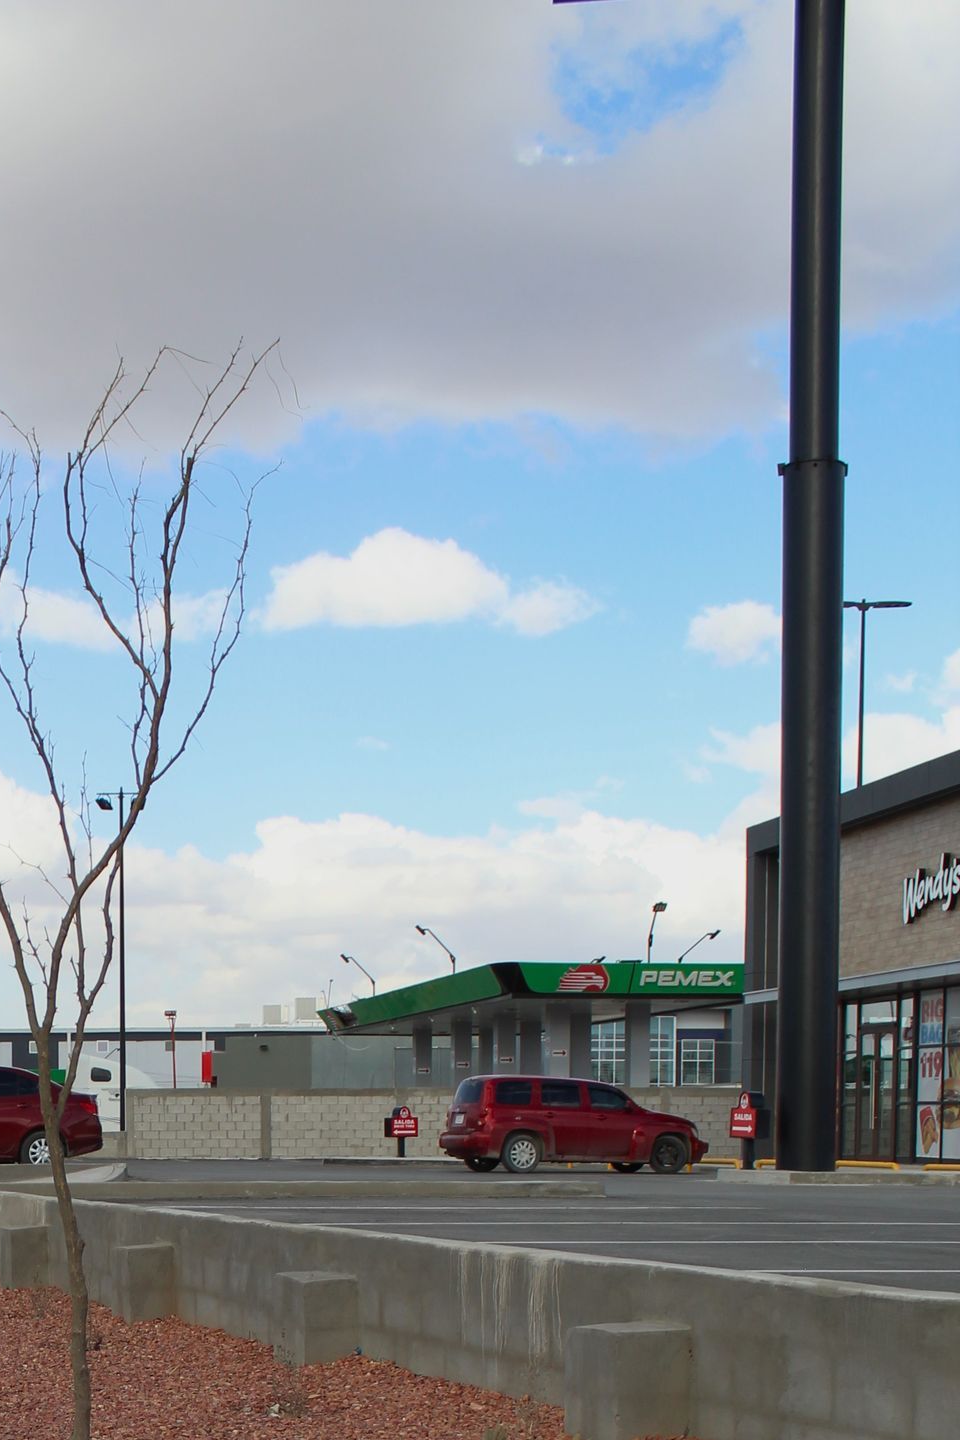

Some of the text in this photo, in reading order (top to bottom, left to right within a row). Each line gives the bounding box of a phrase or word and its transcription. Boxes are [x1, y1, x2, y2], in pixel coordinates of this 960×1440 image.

[903, 852, 960, 924] Wendy's
[640, 971, 734, 986] PEMEX
[734, 1113, 752, 1121] SALIDA
